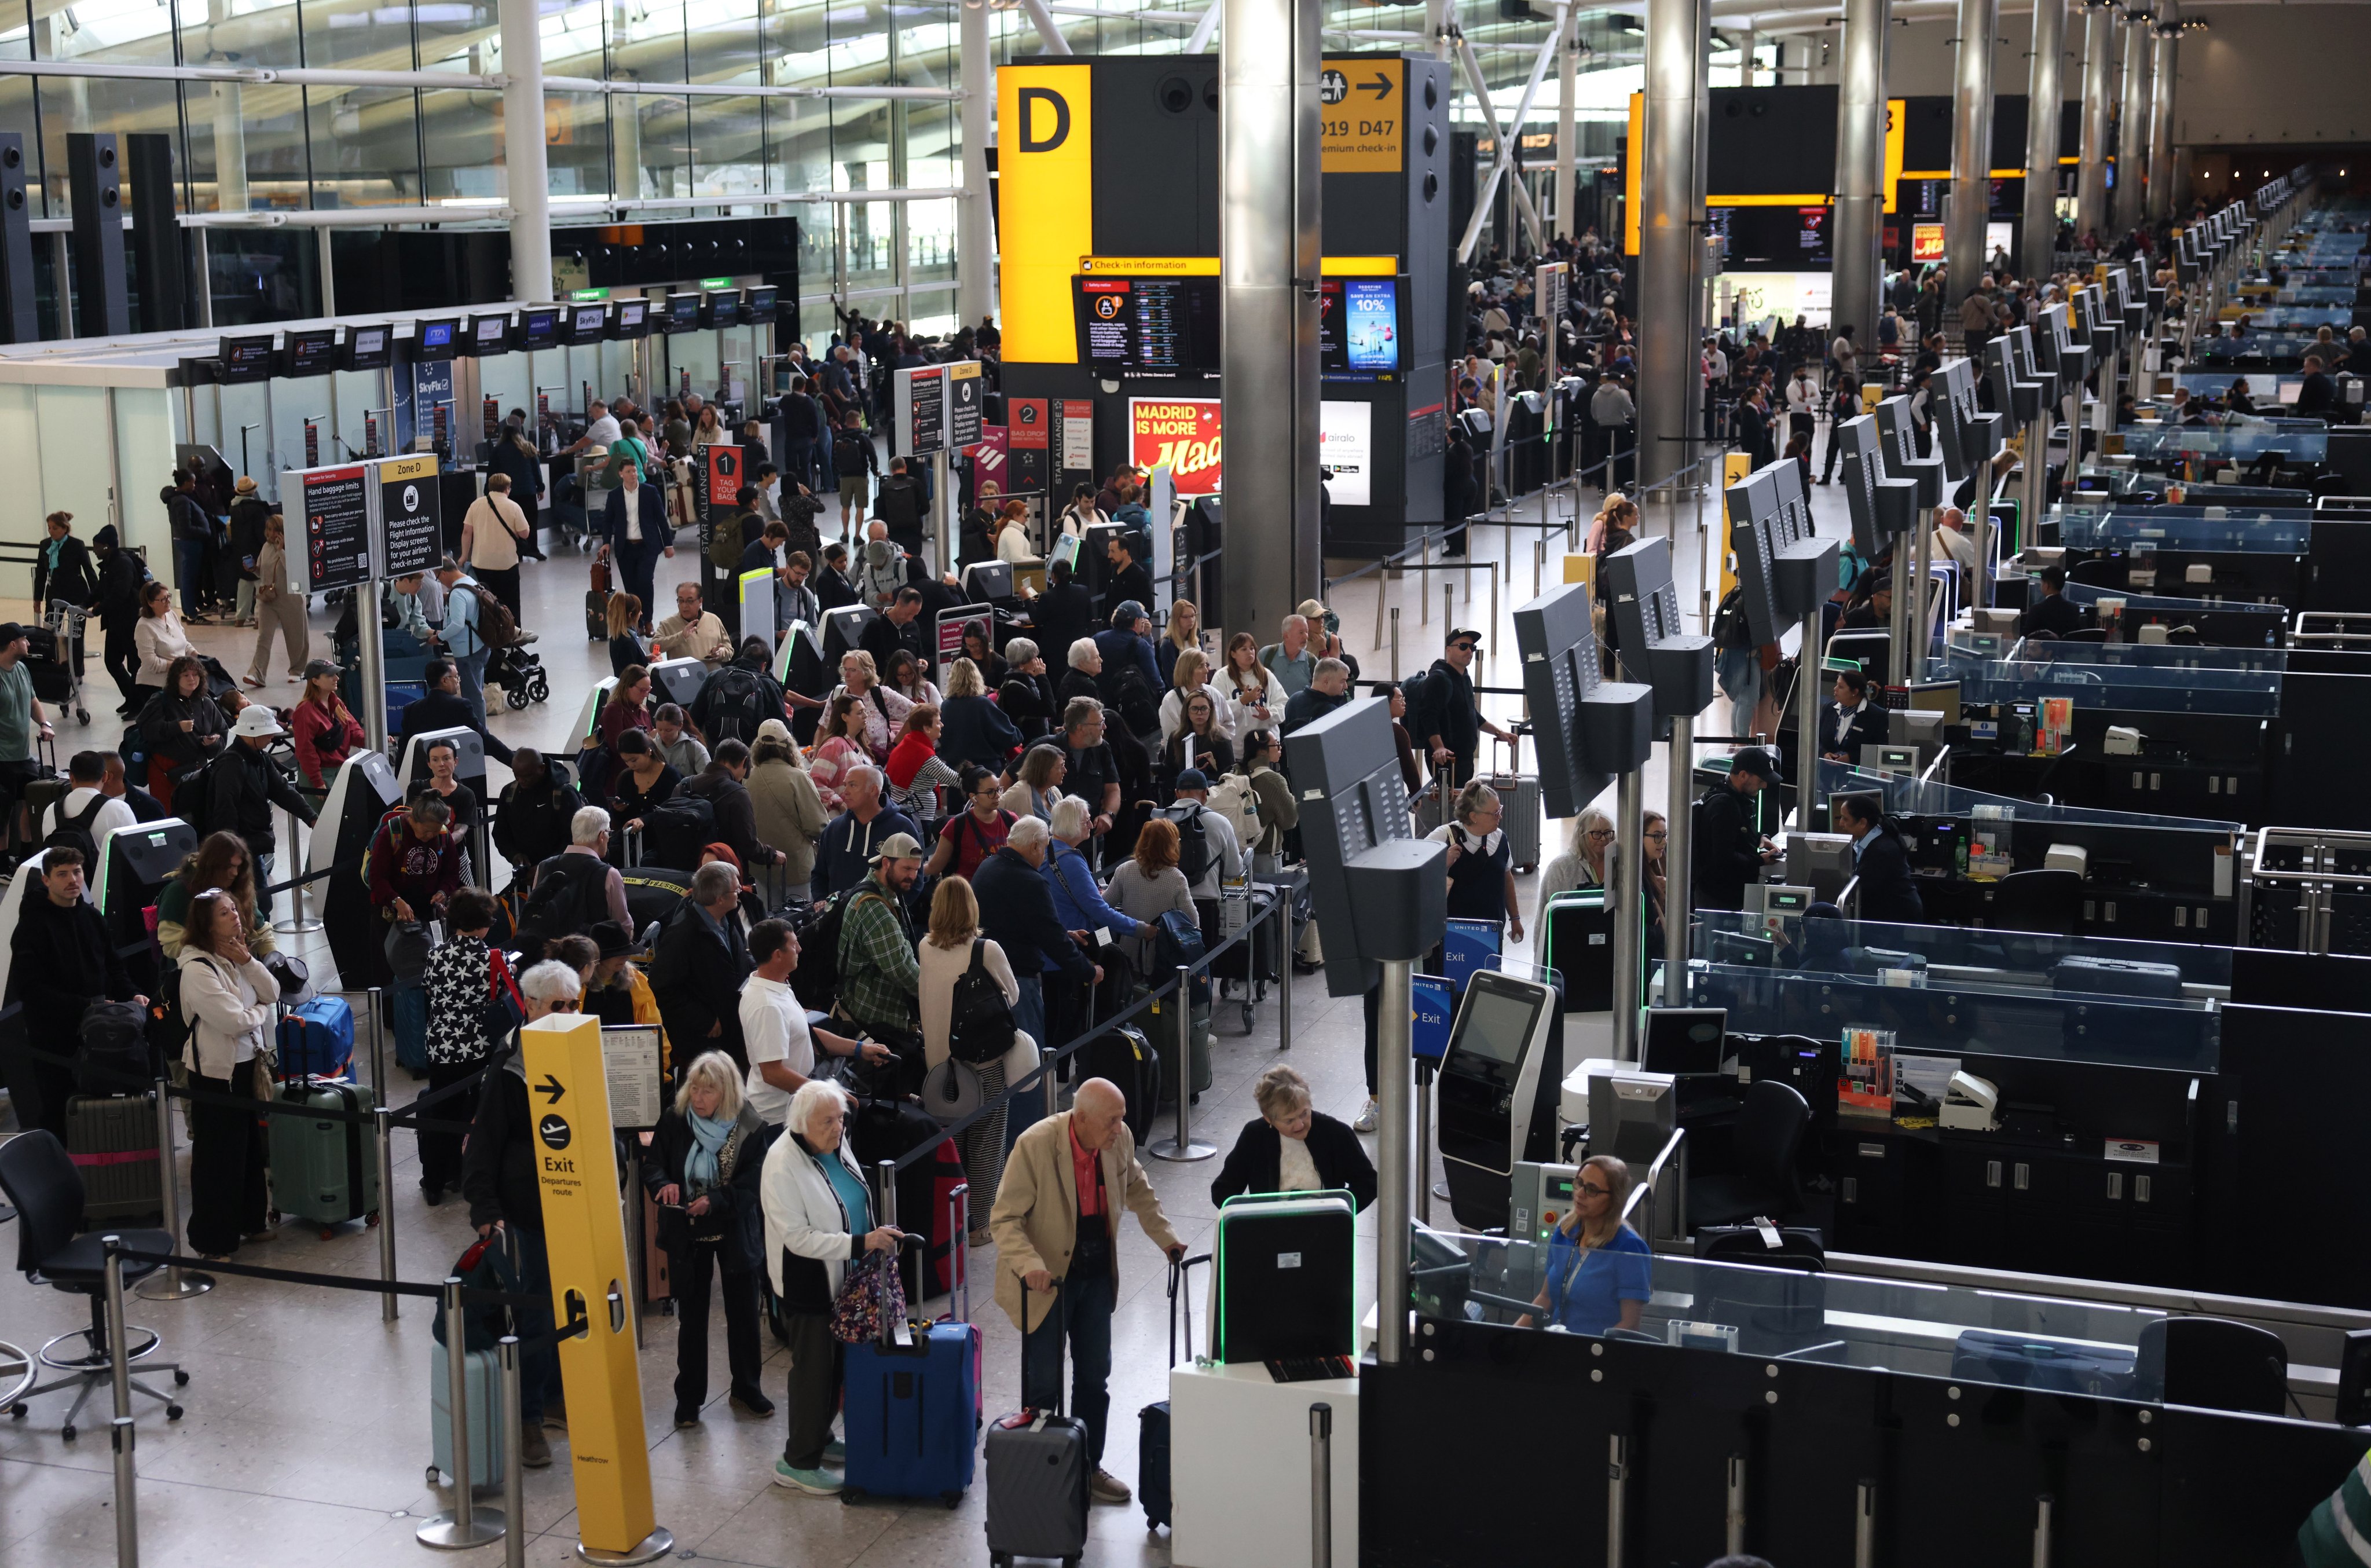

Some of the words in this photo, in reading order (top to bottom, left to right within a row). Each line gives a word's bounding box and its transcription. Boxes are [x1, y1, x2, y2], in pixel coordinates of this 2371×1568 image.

[1019, 87, 1070, 153] D
[1359, 120, 1394, 135] D47
[1321, 144, 1354, 152] emium
[1357, 144, 1396, 152] check-in
[1356, 299, 1386, 312] 10%
[580, 316, 596, 325] SkyFix
[430, 328, 445, 336] ITA
[419, 380, 442, 394] SkyFix
[963, 411, 979, 420] Information
[1023, 407, 1034, 422] 2
[1135, 405, 1197, 419] MADRID
[1136, 420, 1150, 434] IS
[1152, 421, 1197, 435] MORE
[1328, 434, 1355, 442] airalo
[398, 464, 414, 475] Zone
[416, 462, 421, 472] D
[721, 456, 728, 473] 1
[308, 486, 322, 496] Hand
[323, 484, 345, 494] baggage
[346, 482, 360, 491] limits
[699, 461, 709, 521] ALLIANCE
[389, 519, 405, 529] Please
[406, 516, 420, 526] check
[421, 515, 430, 523] the
[390, 529, 404, 540] Flight
[405, 525, 434, 536] Information
[701, 523, 709, 554] STAR
[390, 539, 409, 550] Display
[410, 536, 428, 546] screens
[390, 551, 398, 559] for
[399, 549, 411, 559] your
[412, 545, 431, 555] airline's
[391, 559, 412, 570] check-in
[412, 556, 425, 566] zone
[664, 883, 683, 893] HESS
[1446, 952, 1465, 962] Exit
[1422, 1013, 1441, 1024] Exit
[544, 1156, 575, 1173] Exit
[541, 1176, 582, 1187] Departures
[552, 1188, 573, 1196] route
[577, 1455, 609, 1463] Heathrow
